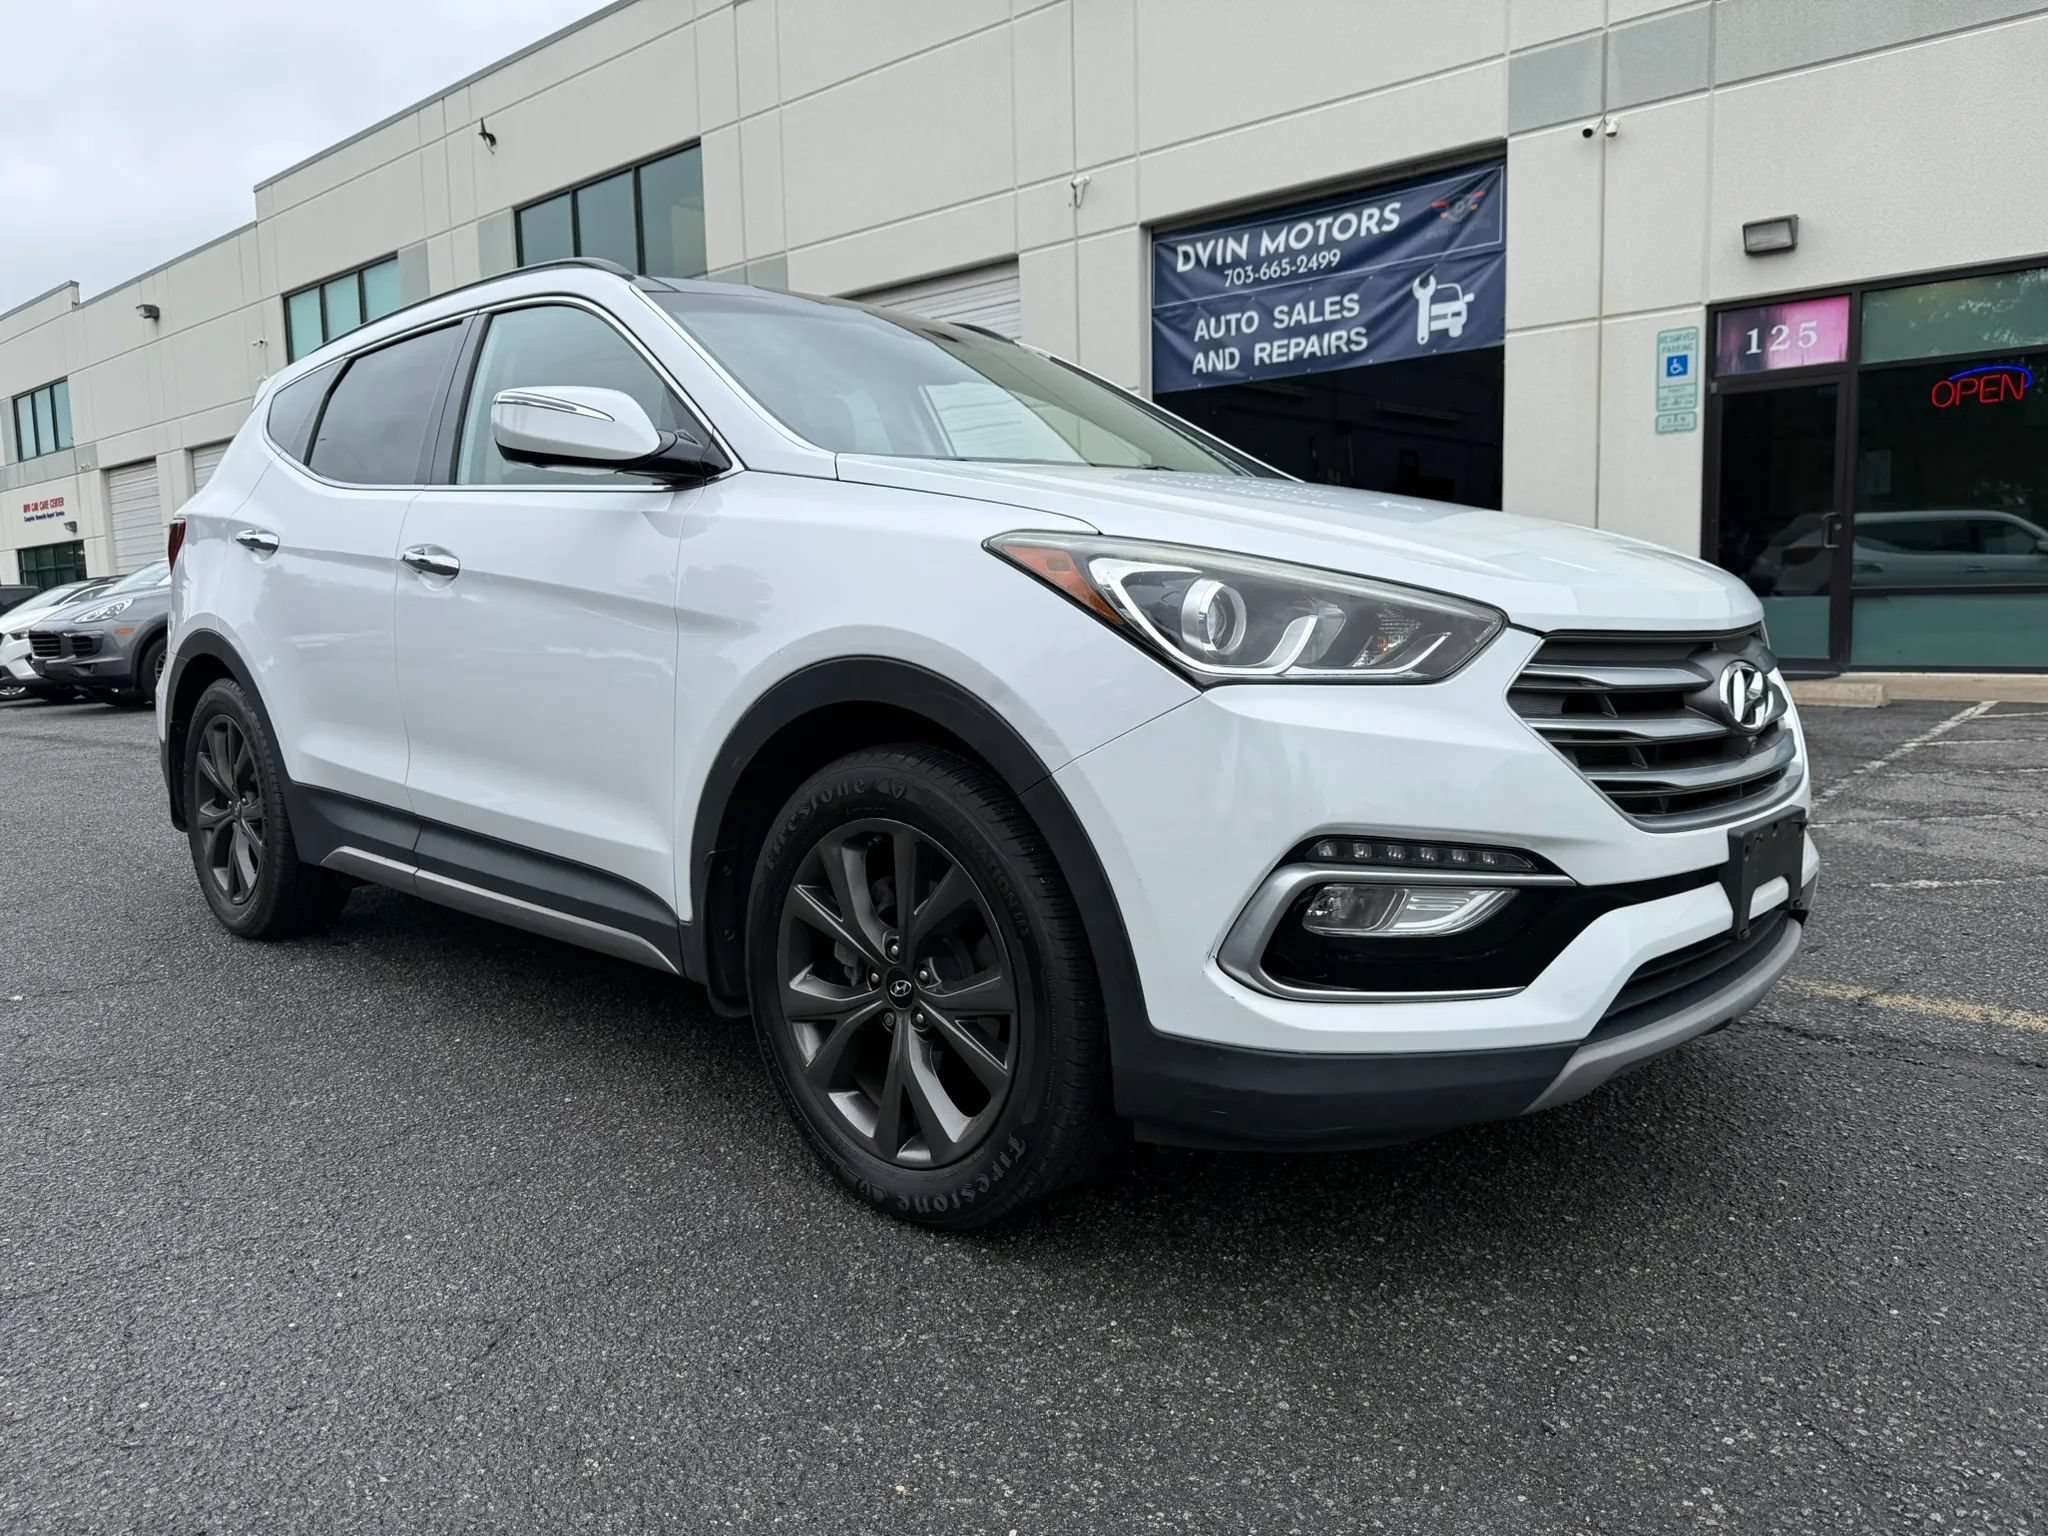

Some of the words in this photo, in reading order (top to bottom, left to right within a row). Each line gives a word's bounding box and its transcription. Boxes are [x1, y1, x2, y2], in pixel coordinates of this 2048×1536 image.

[1176, 232, 1249, 273] DVIN
[1259, 202, 1402, 257] MOTORS
[1224, 249, 1341, 287] 703-665-2499
[1194, 310, 1260, 342] AUTO
[1273, 293, 1361, 329] SALES
[1744, 320, 1819, 355] 125
[1192, 347, 1240, 375] AND
[1254, 327, 1368, 366] REPAIRS
[1661, 342, 1694, 354] PARKING
[1931, 373, 2026, 409] OPEN
[896, 1132, 1027, 1213] Firestone
